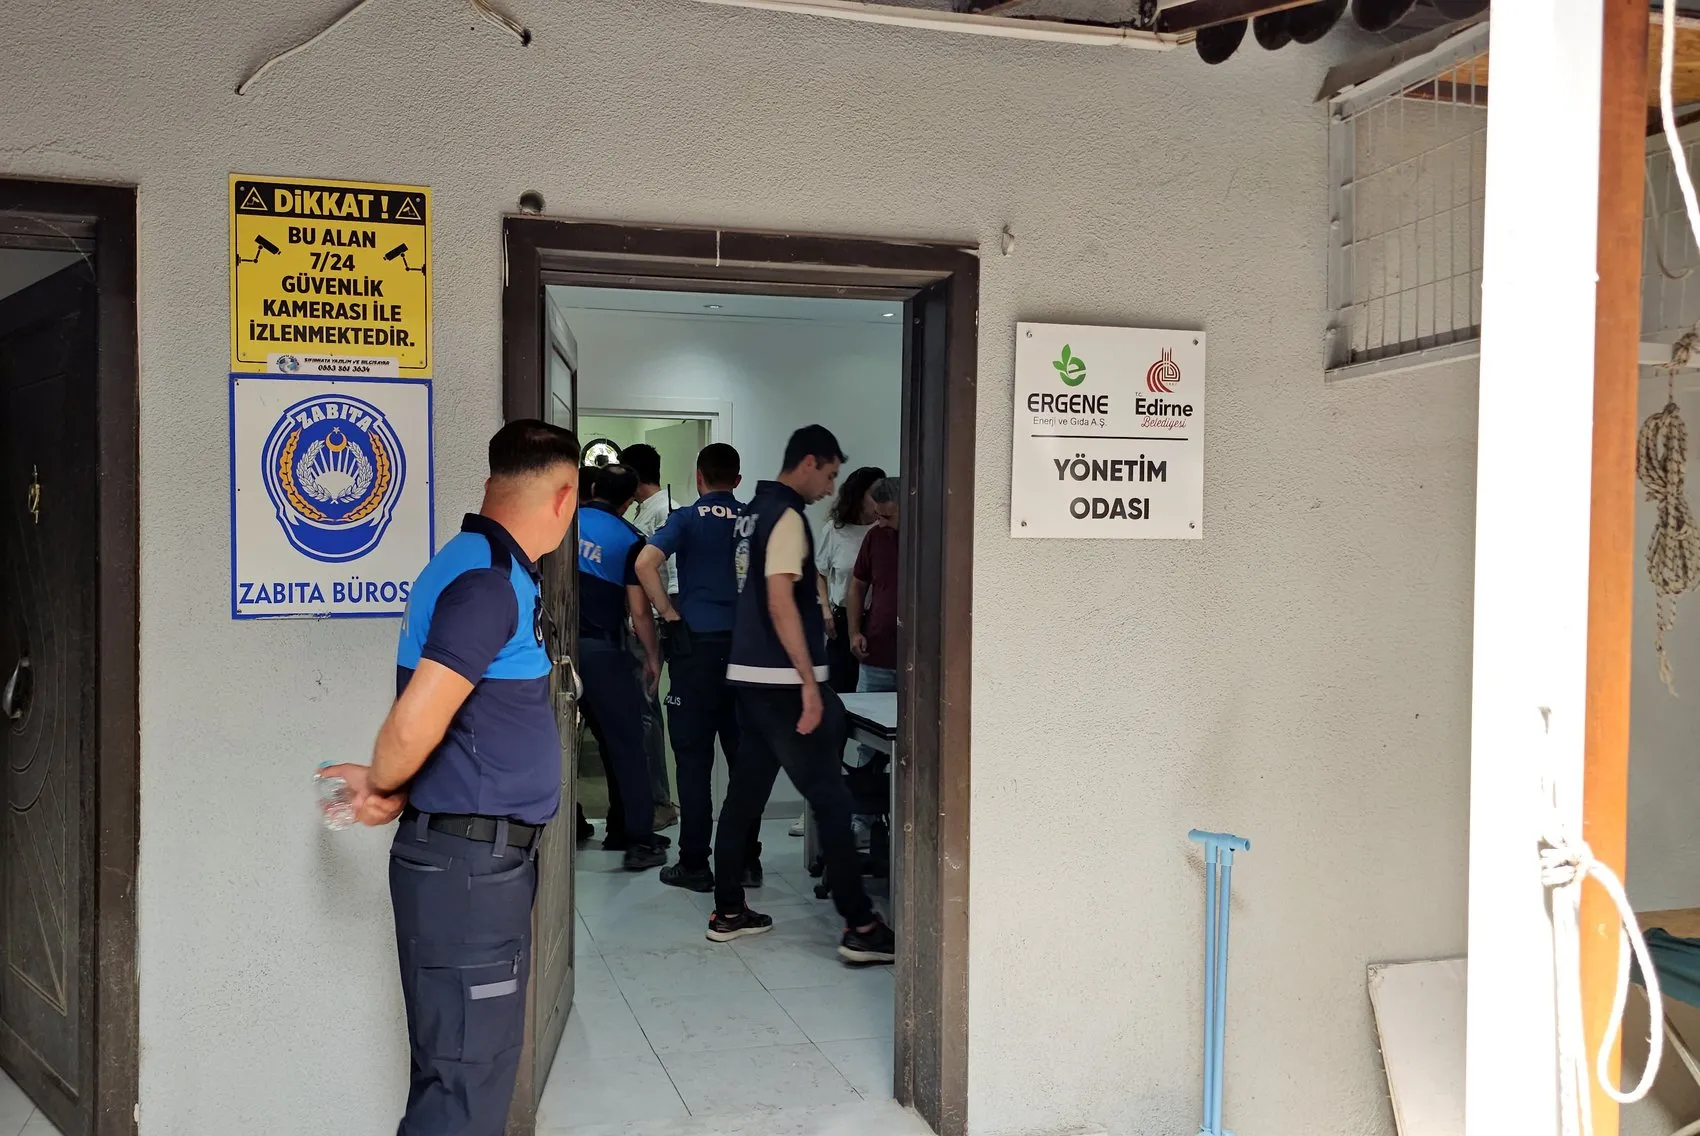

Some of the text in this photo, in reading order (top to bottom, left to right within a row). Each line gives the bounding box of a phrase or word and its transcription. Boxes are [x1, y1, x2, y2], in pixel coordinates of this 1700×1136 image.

[288, 226, 376, 249] BU ALAN
[310, 251, 355, 272] 7/24
[281, 272, 384, 297] GÜVENLİK
[263, 299, 402, 322] KAMERASI İLE
[249, 319, 415, 347] İZLENMEKTEDİR.
[1027, 393, 1109, 414] ERGENE
[1135, 398, 1193, 417] Edirne
[296, 403, 374, 432] ZABITA
[1033, 416, 1056, 427] Enerji
[1141, 416, 1187, 431] Belediyesi
[1053, 452, 1167, 482] YÖNETİM
[697, 505, 742, 519] POL
[1069, 496, 1150, 520] ODASI
[239, 576, 411, 604] ZABITA BÜROS
